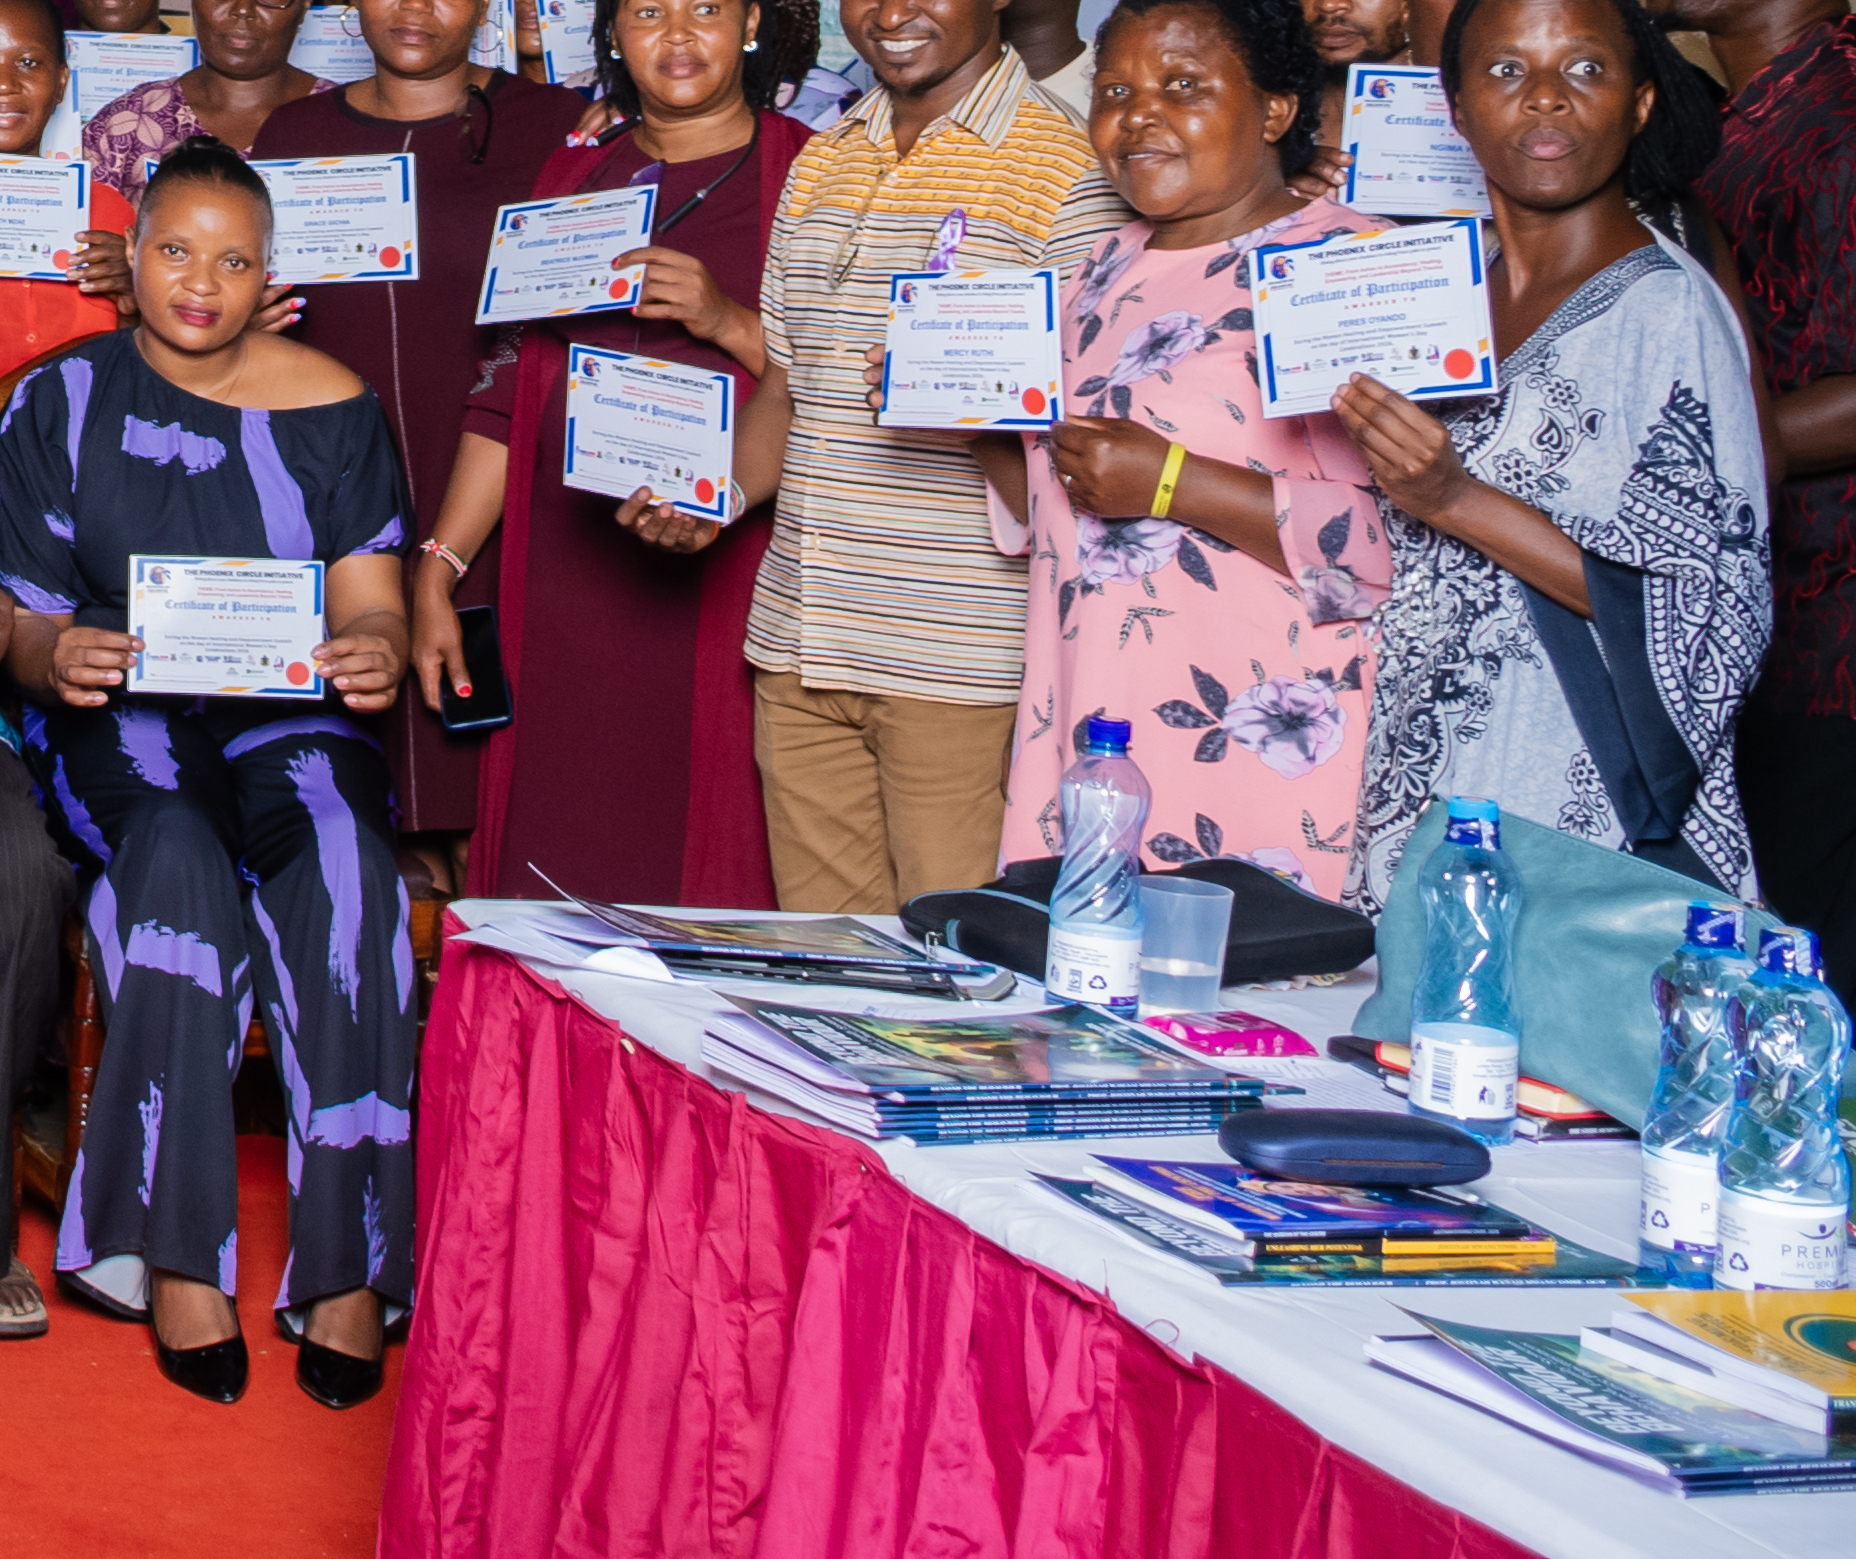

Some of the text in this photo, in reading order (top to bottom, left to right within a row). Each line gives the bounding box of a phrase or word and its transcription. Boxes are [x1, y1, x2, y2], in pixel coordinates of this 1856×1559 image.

[1308, 234, 1455, 260] THE PHOENIX CIRCLE INITIATIVE
[1290, 277, 1450, 307] Certificate of Participation
